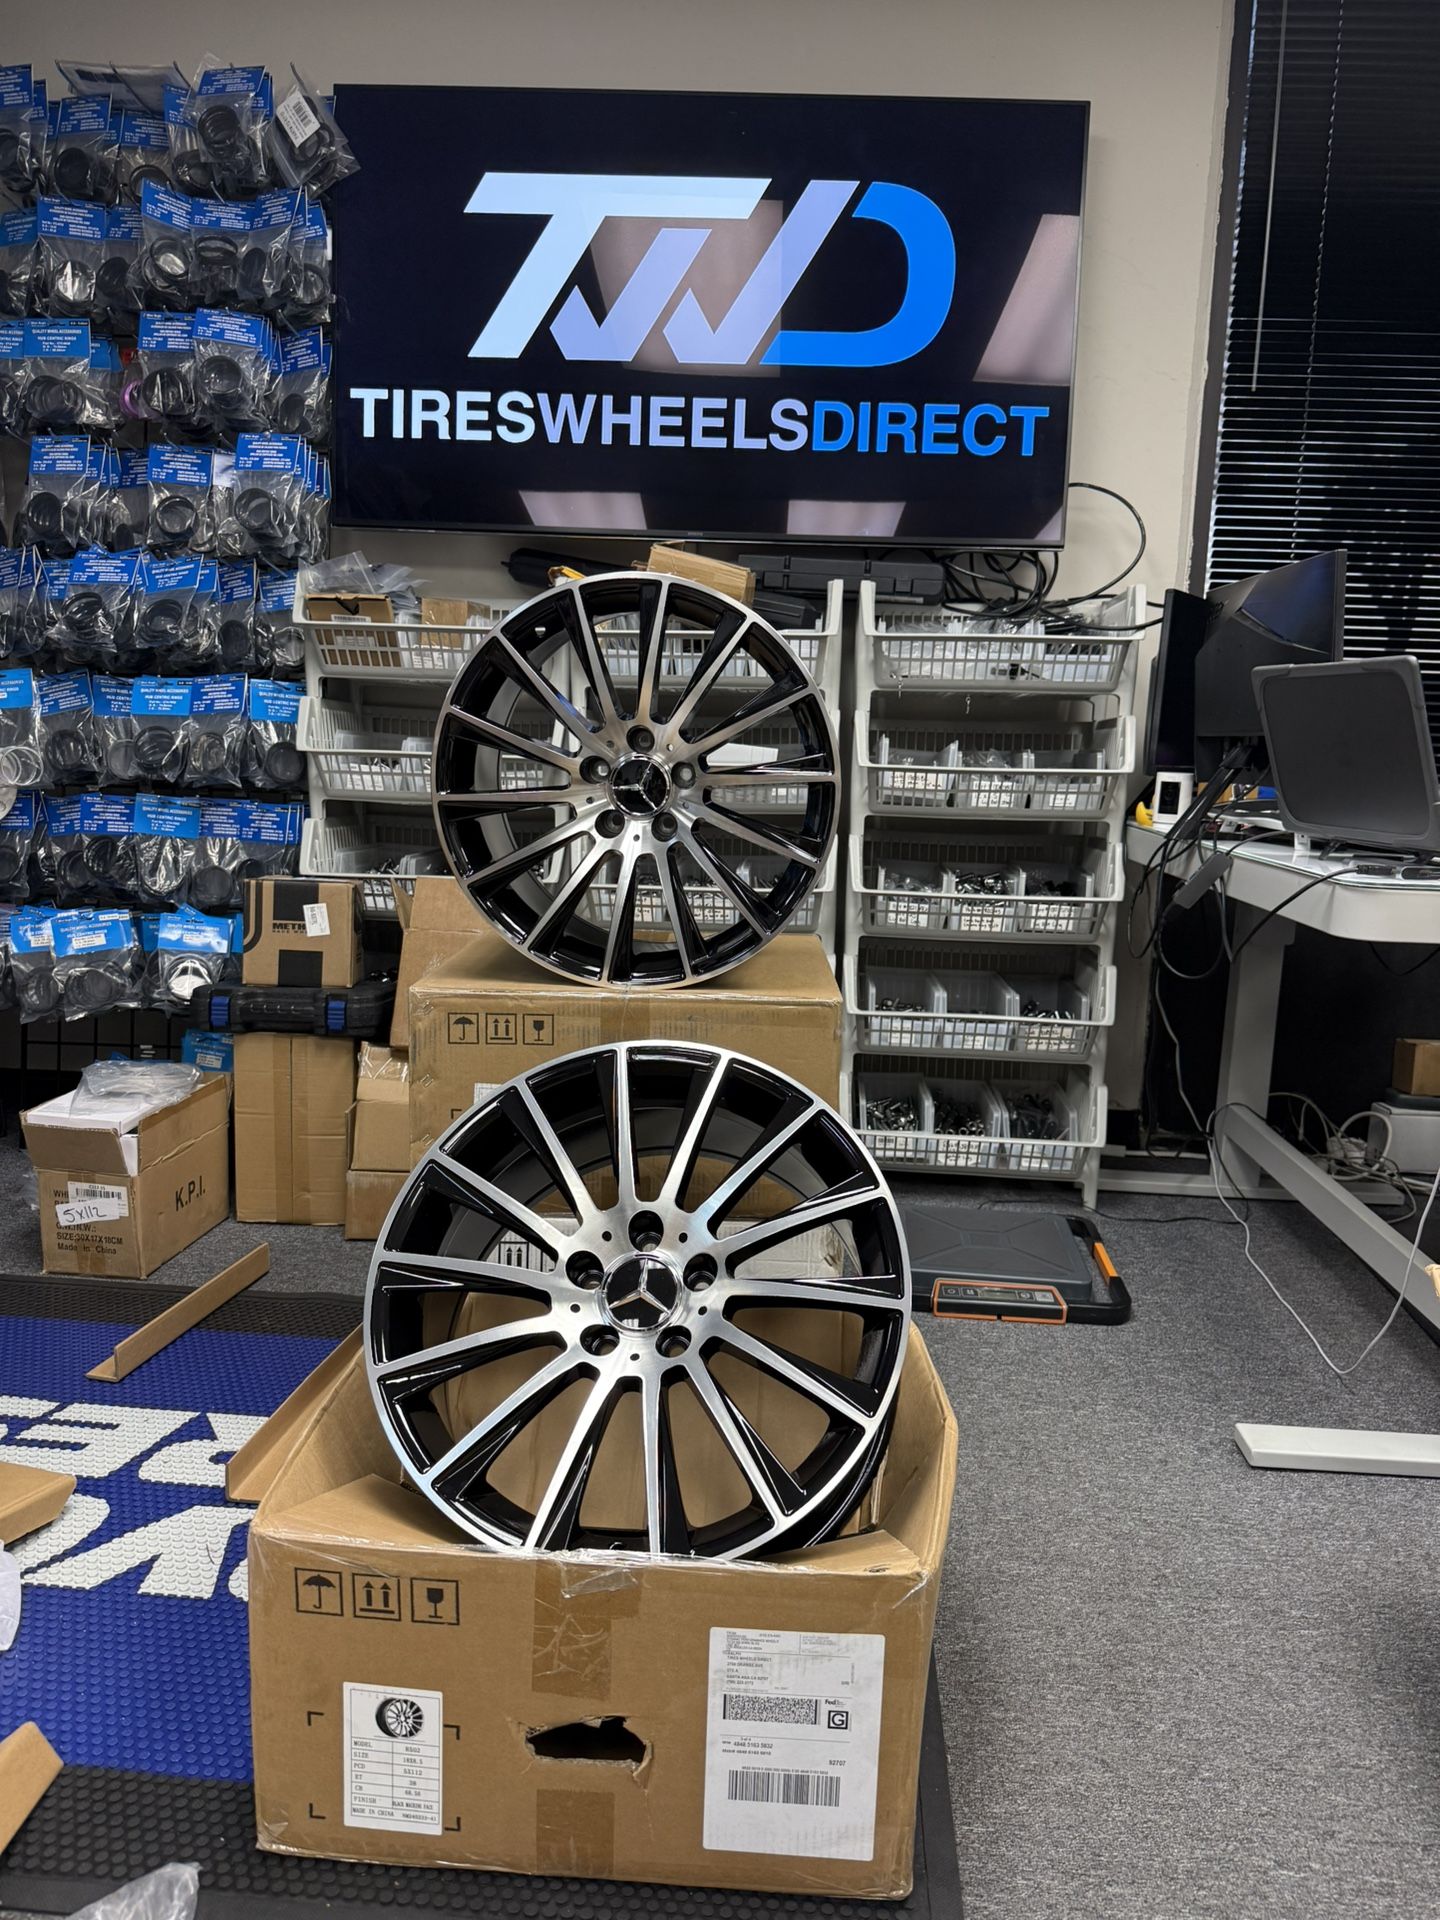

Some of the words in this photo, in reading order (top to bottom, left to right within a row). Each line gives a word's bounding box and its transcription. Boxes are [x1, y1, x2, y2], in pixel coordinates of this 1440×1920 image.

[350, 387, 1050, 457] TIRESWHEELSDIRECT
[176, 1175, 206, 1212] K.P.I.
[58, 1242, 78, 1251] Made
[96, 1245, 117, 1254] China
[831, 1712, 845, 1726] G
